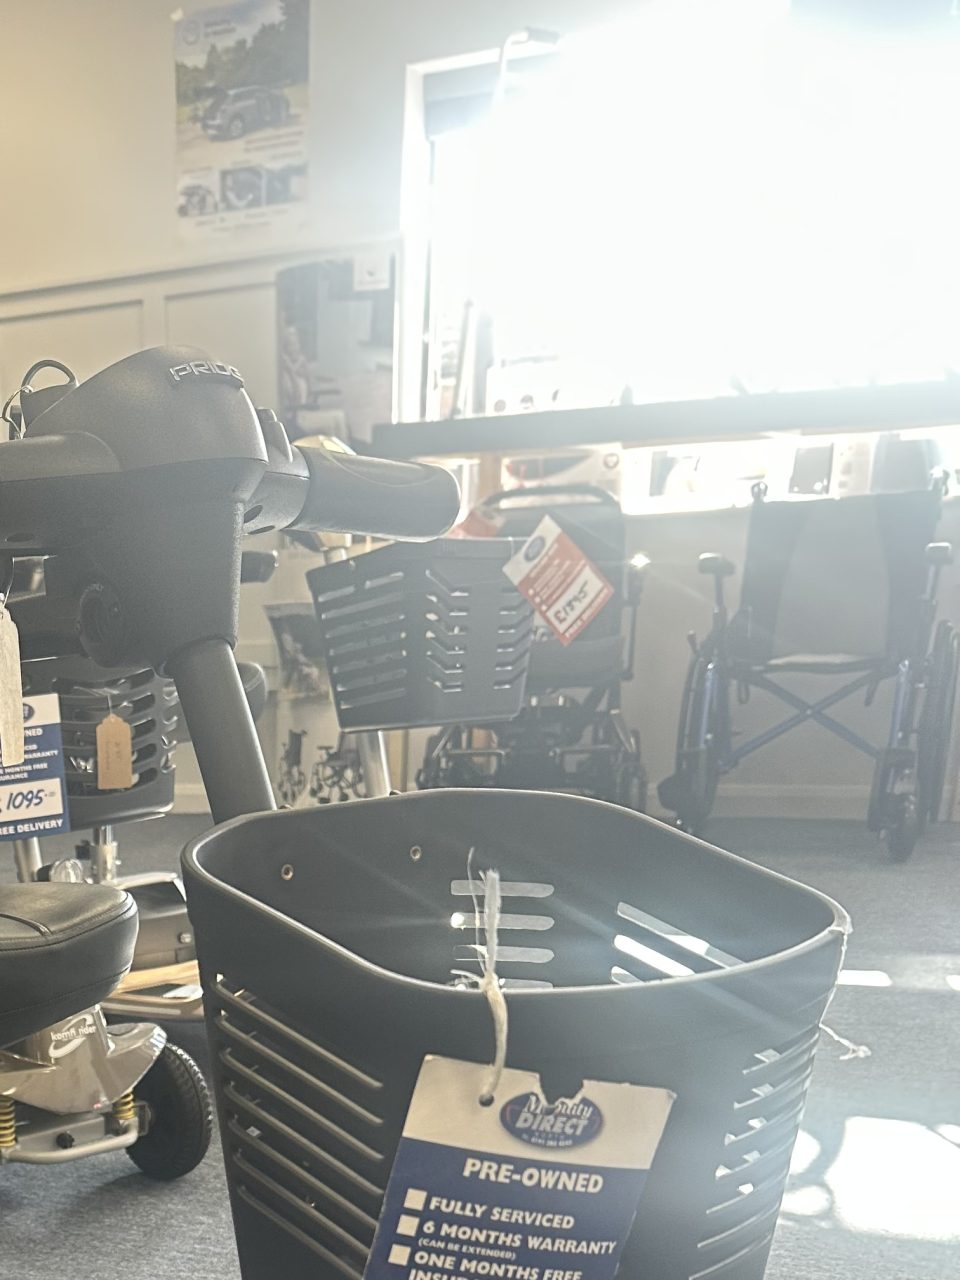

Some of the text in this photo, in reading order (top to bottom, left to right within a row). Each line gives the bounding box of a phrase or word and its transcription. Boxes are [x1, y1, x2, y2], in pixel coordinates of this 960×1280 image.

[169, 361, 244, 381] PRIDE
[17, 818, 64, 833] DELIVERY
[515, 1111, 589, 1136] DIRECT
[462, 1157, 604, 1194] PRE-OWNED
[429, 1196, 575, 1230] FULLY SERVICED
[417, 1237, 516, 1261] (CAN BE EXTENDED)
[422, 1220, 618, 1255] 6 MONTHS WARRANTY
[414, 1251, 456, 1270] ONE
[459, 1260, 539, 1280] MONTHS
